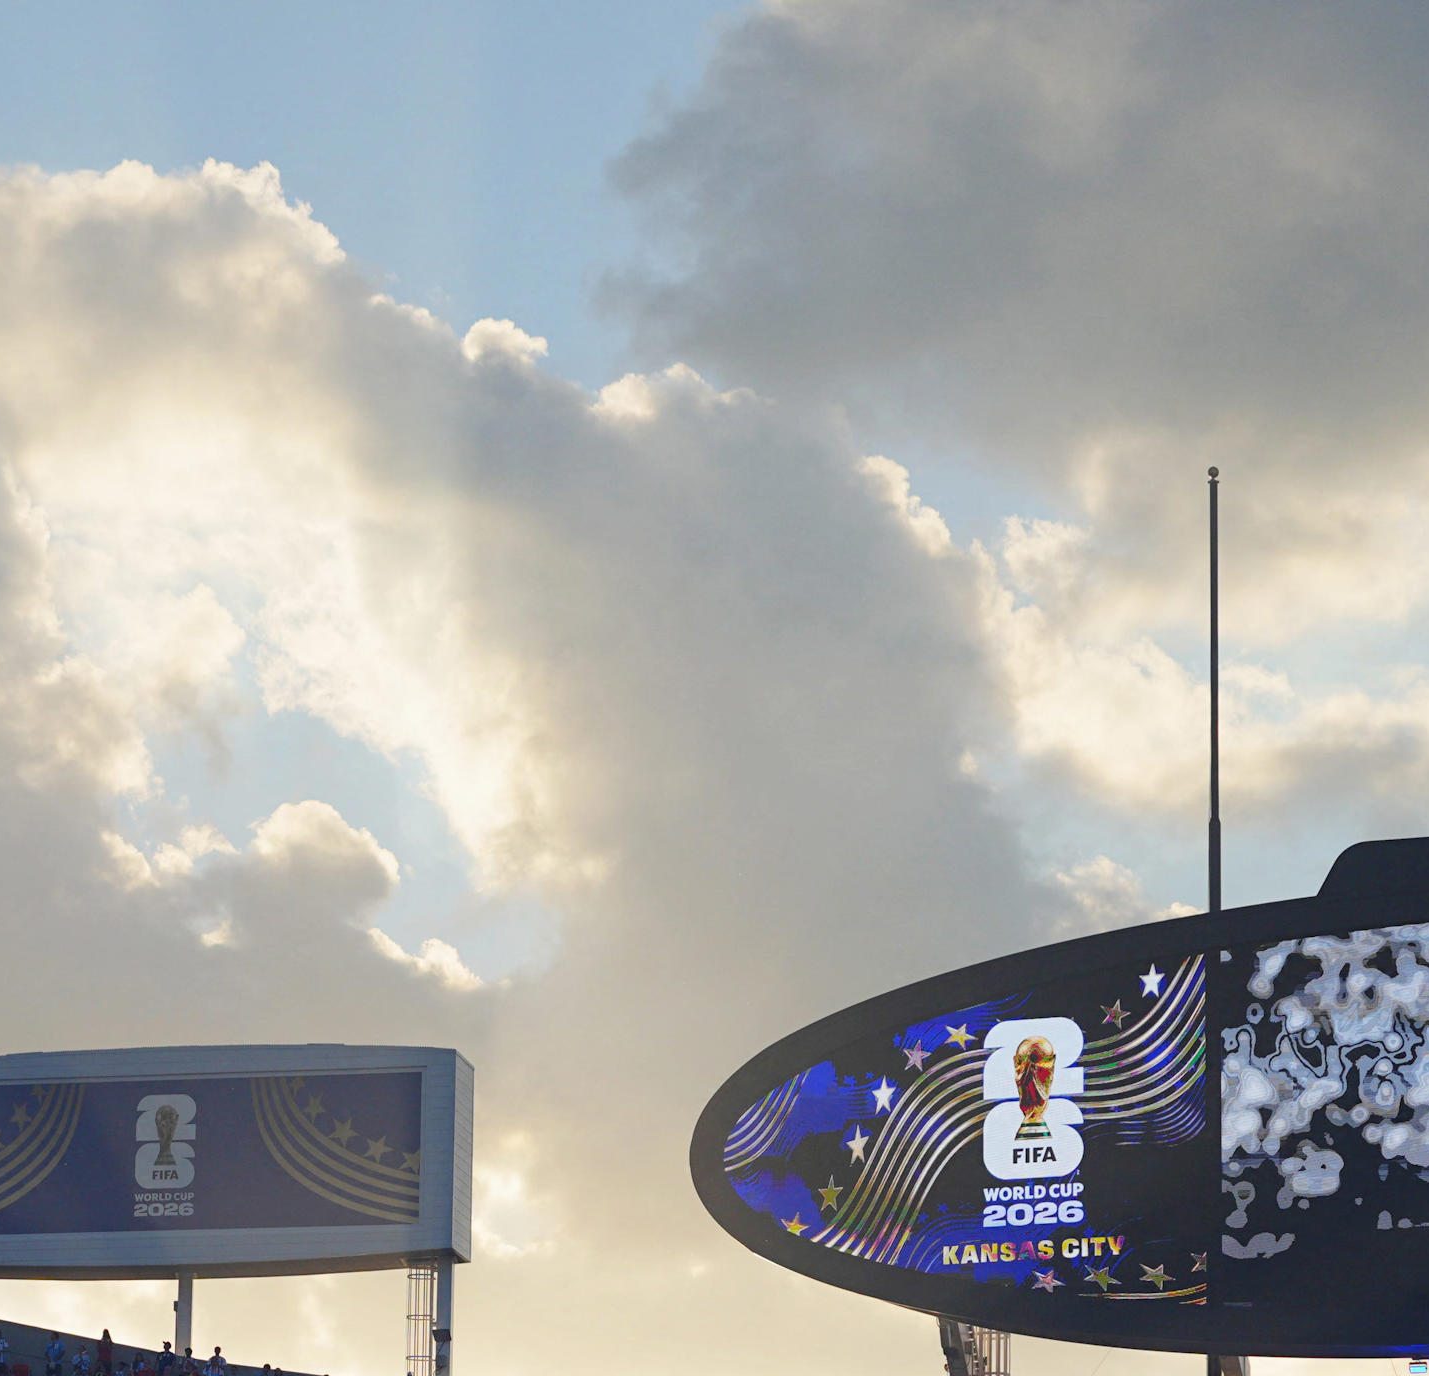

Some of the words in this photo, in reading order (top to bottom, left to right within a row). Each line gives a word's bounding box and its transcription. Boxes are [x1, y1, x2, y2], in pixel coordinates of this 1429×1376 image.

[1012, 1146, 1057, 1164] FIFA
[152, 1170, 179, 1180] FIFA
[134, 1193, 172, 1202] WORLD
[173, 1192, 195, 1201] CUP
[983, 1184, 1047, 1202] WORLD
[1048, 1182, 1084, 1199] CUP
[133, 1202, 195, 1217] 2026
[982, 1200, 1084, 1228] 2026
[942, 1240, 1054, 1265] KANSAS
[1061, 1235, 1125, 1259] CITY
